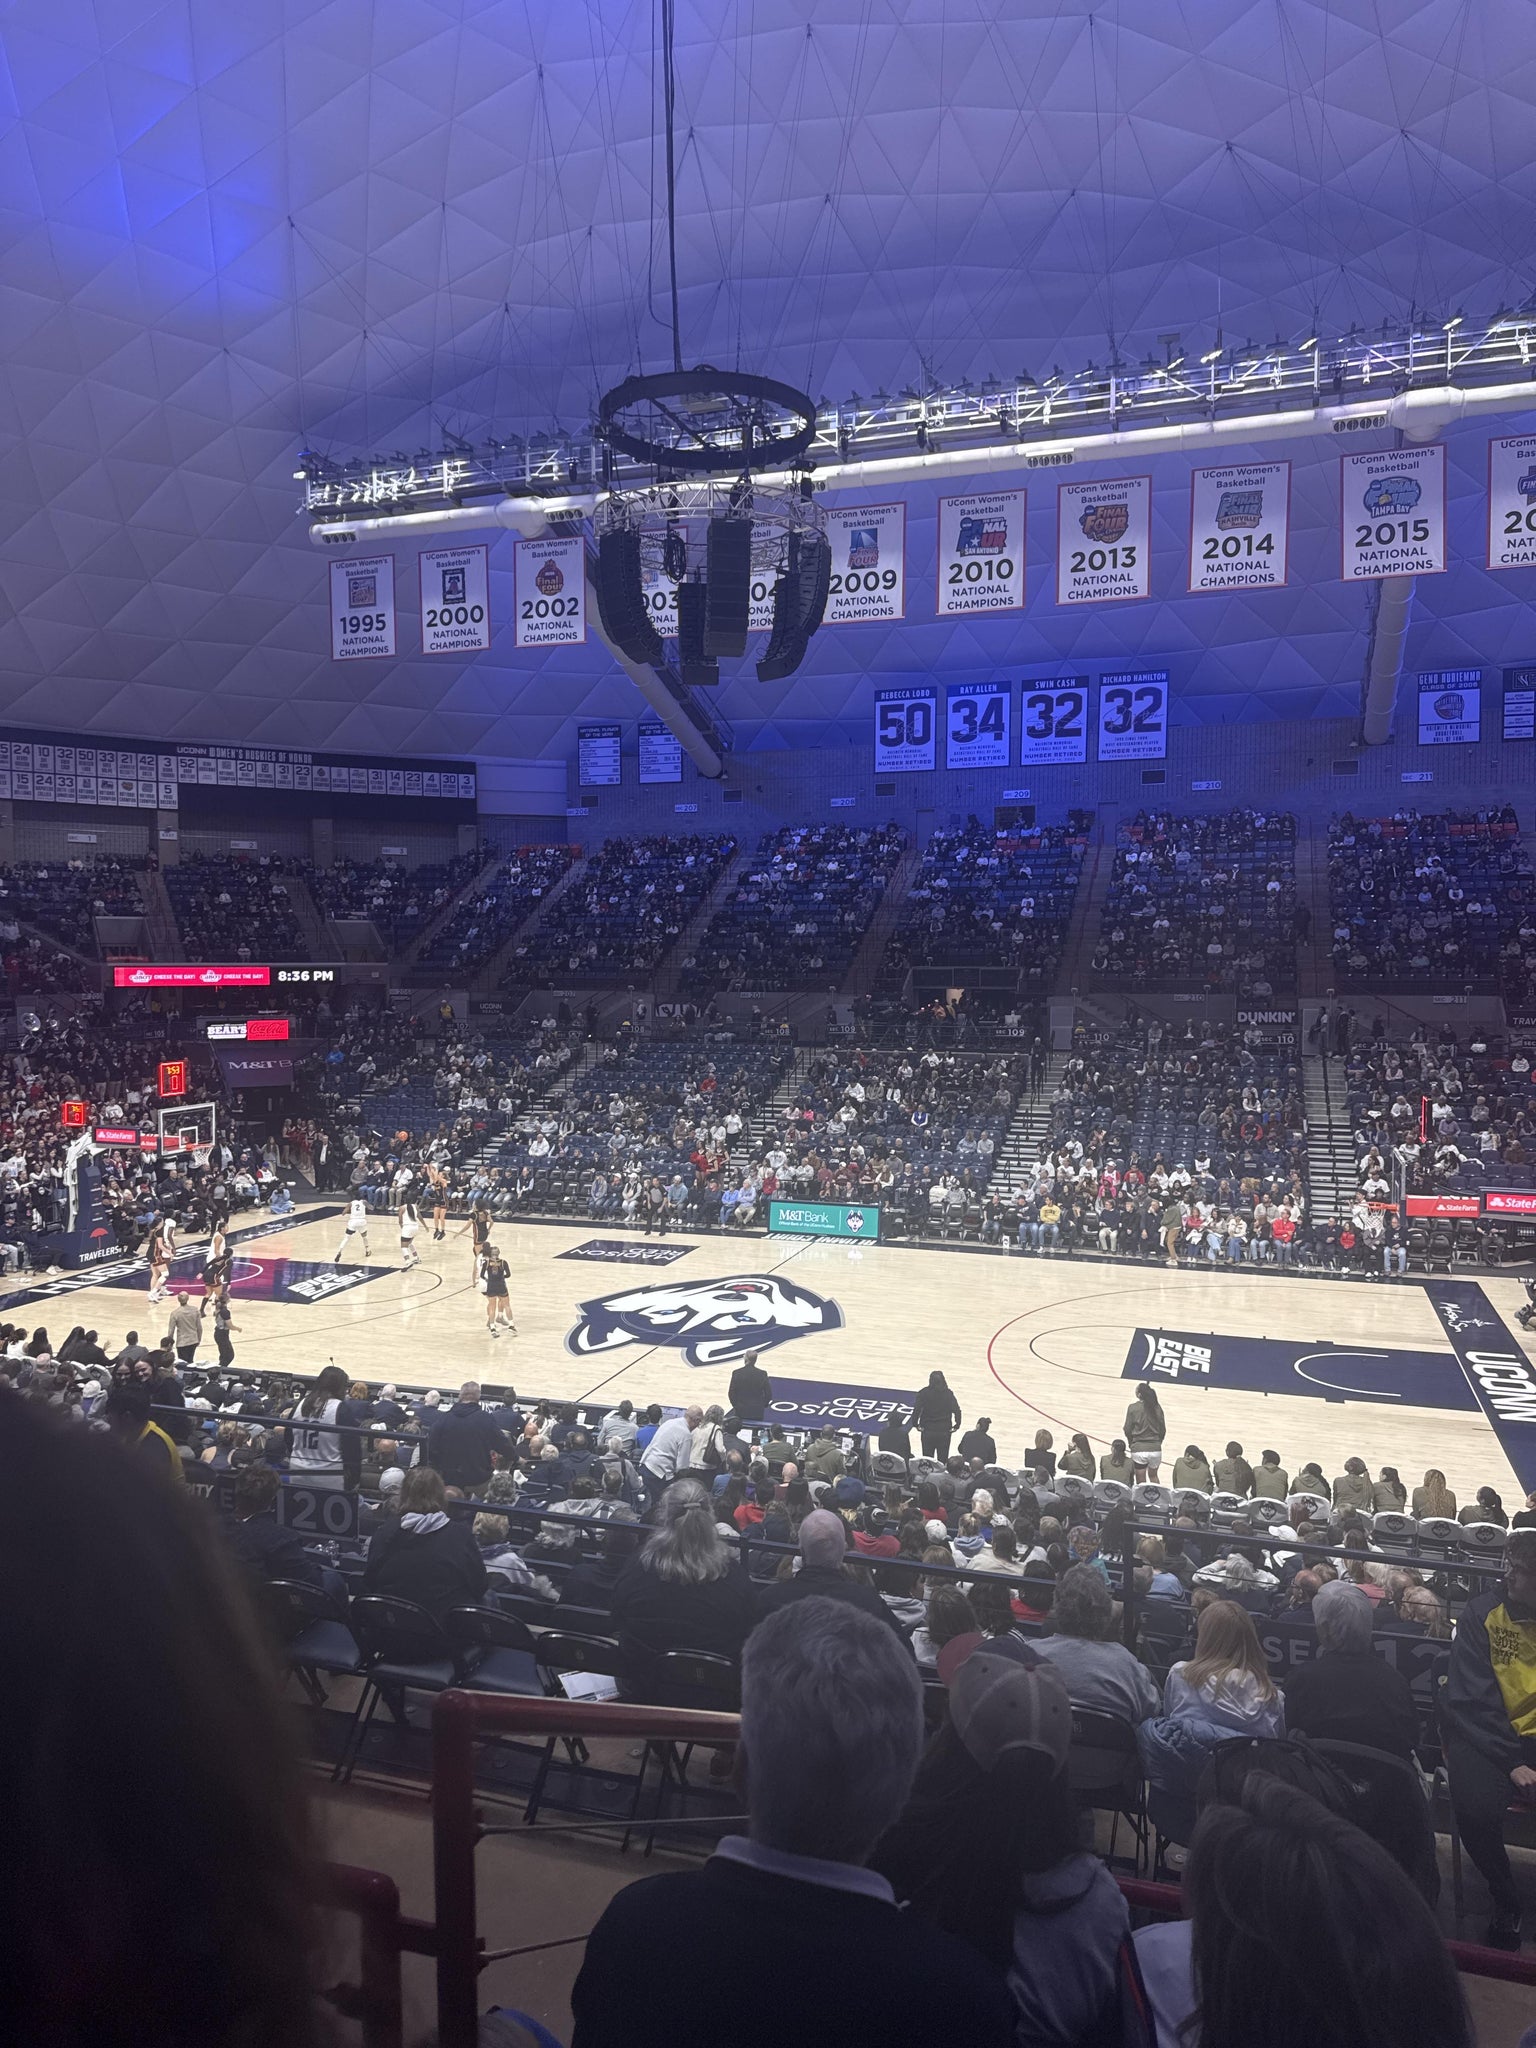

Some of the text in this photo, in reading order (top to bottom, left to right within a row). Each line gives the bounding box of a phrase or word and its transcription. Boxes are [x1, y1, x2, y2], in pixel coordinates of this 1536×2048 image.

[1352, 449, 1435, 465] UConn Women's
[1202, 465, 1280, 479] UConn Women's
[1367, 461, 1419, 475] Basketball
[1067, 480, 1141, 495] UConn Women's
[1216, 477, 1266, 489] Basketball
[947, 493, 1018, 508] UConn Women's
[1081, 491, 1128, 504] Basketball
[830, 505, 897, 520] UConn Women's
[960, 505, 1005, 517] Basketball
[843, 517, 885, 528] Basketball
[1355, 519, 1429, 547] 2015
[1202, 532, 1275, 560] 2014
[426, 552, 448, 561] UConn
[531, 548, 568, 558] Basketball
[1360, 547, 1427, 561] NATIONAL
[436, 558, 471, 568] Basketball
[1070, 546, 1136, 573] 2013
[345, 567, 379, 577] Basketball
[948, 559, 1014, 584] 2010
[1206, 560, 1270, 574] NATIONAL
[1353, 560, 1433, 576] CHAMPIONS
[829, 569, 897, 594] 2009
[1073, 573, 1133, 586] NATIONAL
[1200, 573, 1275, 588] CHAMPIONS
[952, 583, 1010, 597] NATIONAL
[1068, 585, 1138, 600] CHAMPIONS
[835, 595, 890, 607] NATIONAL
[947, 597, 1014, 611] CHAMPIONS
[521, 597, 579, 619] 2002
[831, 606, 894, 620] CHAMPIONS
[426, 604, 484, 628] 2000
[339, 612, 387, 634] 1995
[527, 620, 574, 632] NATIONAL
[433, 627, 478, 639] NATIONAL
[523, 631, 578, 643] CHAMPIONS
[342, 634, 385, 646] NATIONAL
[430, 638, 482, 651] CHAMPIONS
[339, 645, 389, 657] CHAMPIONS
[1035, 678, 1076, 689] SWIN CASH
[1103, 672, 1167, 684] RICHARD HAMILTON
[881, 689, 930, 700] REBECCA LOBO
[960, 684, 998, 695] RAY ALLEN
[1026, 692, 1083, 739] 32
[1103, 686, 1163, 734] 32
[879, 702, 931, 747] 50
[951, 698, 1005, 744] 34
[13, 745, 30, 756] 24
[38, 747, 50, 757] 10
[58, 748, 73, 758] 32
[78, 750, 94, 760] 50
[176, 746, 207, 755] UCONN
[99, 752, 115, 762] 33
[121, 754, 133, 763] 21
[139, 756, 155, 765] 42
[164, 757, 172, 767] 3
[180, 759, 195, 768] 52
[239, 762, 254, 772] 20
[279, 765, 289, 774] 31
[296, 767, 310, 776] 23
[407, 773, 420, 782] 23
[17, 774, 29, 784] 15
[36, 775, 53, 785] 24
[58, 777, 74, 787] 33
[443, 775, 456, 784] 30
[164, 784, 172, 794] 5
[278, 970, 334, 981] 8:36 PM
[1237, 1012, 1296, 1023] DUNKIN'
[1008, 1028, 1025, 1036] 109
[1094, 1033, 1110, 1041] 110
[1277, 1036, 1294, 1044] 110
[779, 1209, 829, 1223] M&T Bank
[79, 1245, 120, 1262] TRAVELERS
[570, 1249, 677, 1260] MADISON
[1152, 1337, 1183, 1378] EAST
[1181, 1343, 1212, 1374] BIG
[832, 1397, 915, 1416] REED
[277, 1489, 353, 1535] 120
